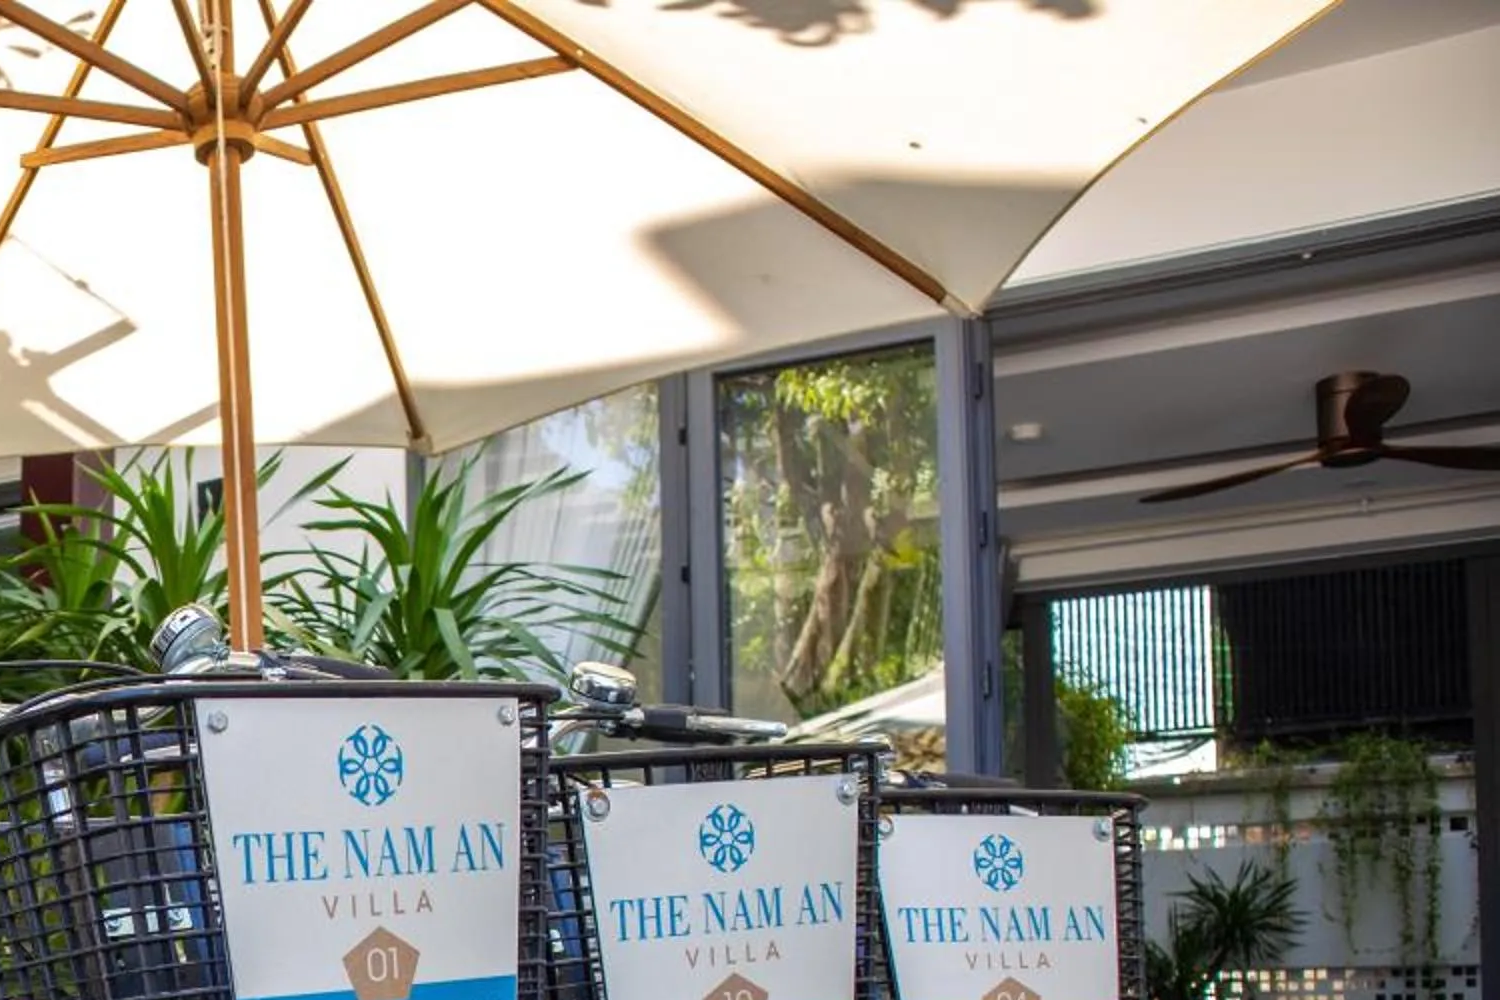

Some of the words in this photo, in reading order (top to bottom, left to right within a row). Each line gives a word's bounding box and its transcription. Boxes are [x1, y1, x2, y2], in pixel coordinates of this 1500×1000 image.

[232, 830, 329, 884] THE
[343, 825, 437, 879] NAM
[452, 822, 506, 873] AN
[322, 890, 433, 920] VILLA
[609, 895, 691, 942] THE
[702, 886, 784, 935] NAM
[797, 881, 844, 926] AN
[897, 906, 969, 943] THE
[979, 906, 1053, 943] NAM
[1063, 905, 1107, 942] AN
[365, 946, 400, 982] 01
[684, 939, 781, 969] VILLA
[965, 951, 1051, 970] VILLA
